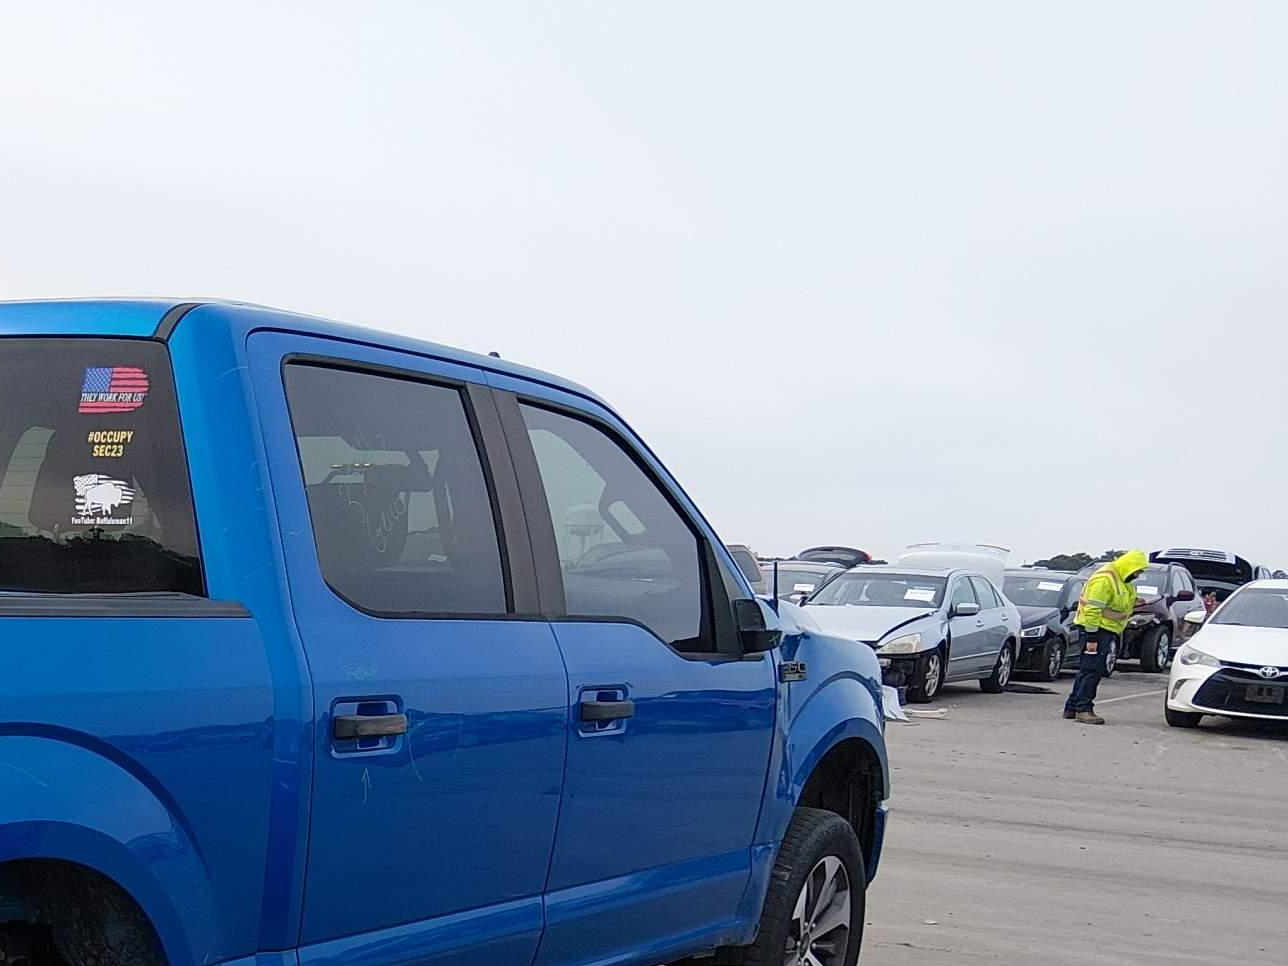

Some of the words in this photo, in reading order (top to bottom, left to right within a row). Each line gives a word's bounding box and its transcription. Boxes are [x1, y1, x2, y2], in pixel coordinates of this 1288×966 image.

[80, 393, 98, 402] THEY
[98, 393, 118, 402] WORK
[118, 393, 133, 402] FOR
[88, 431, 134, 443] #OCCUPY
[92, 444, 124, 457] SEC23
